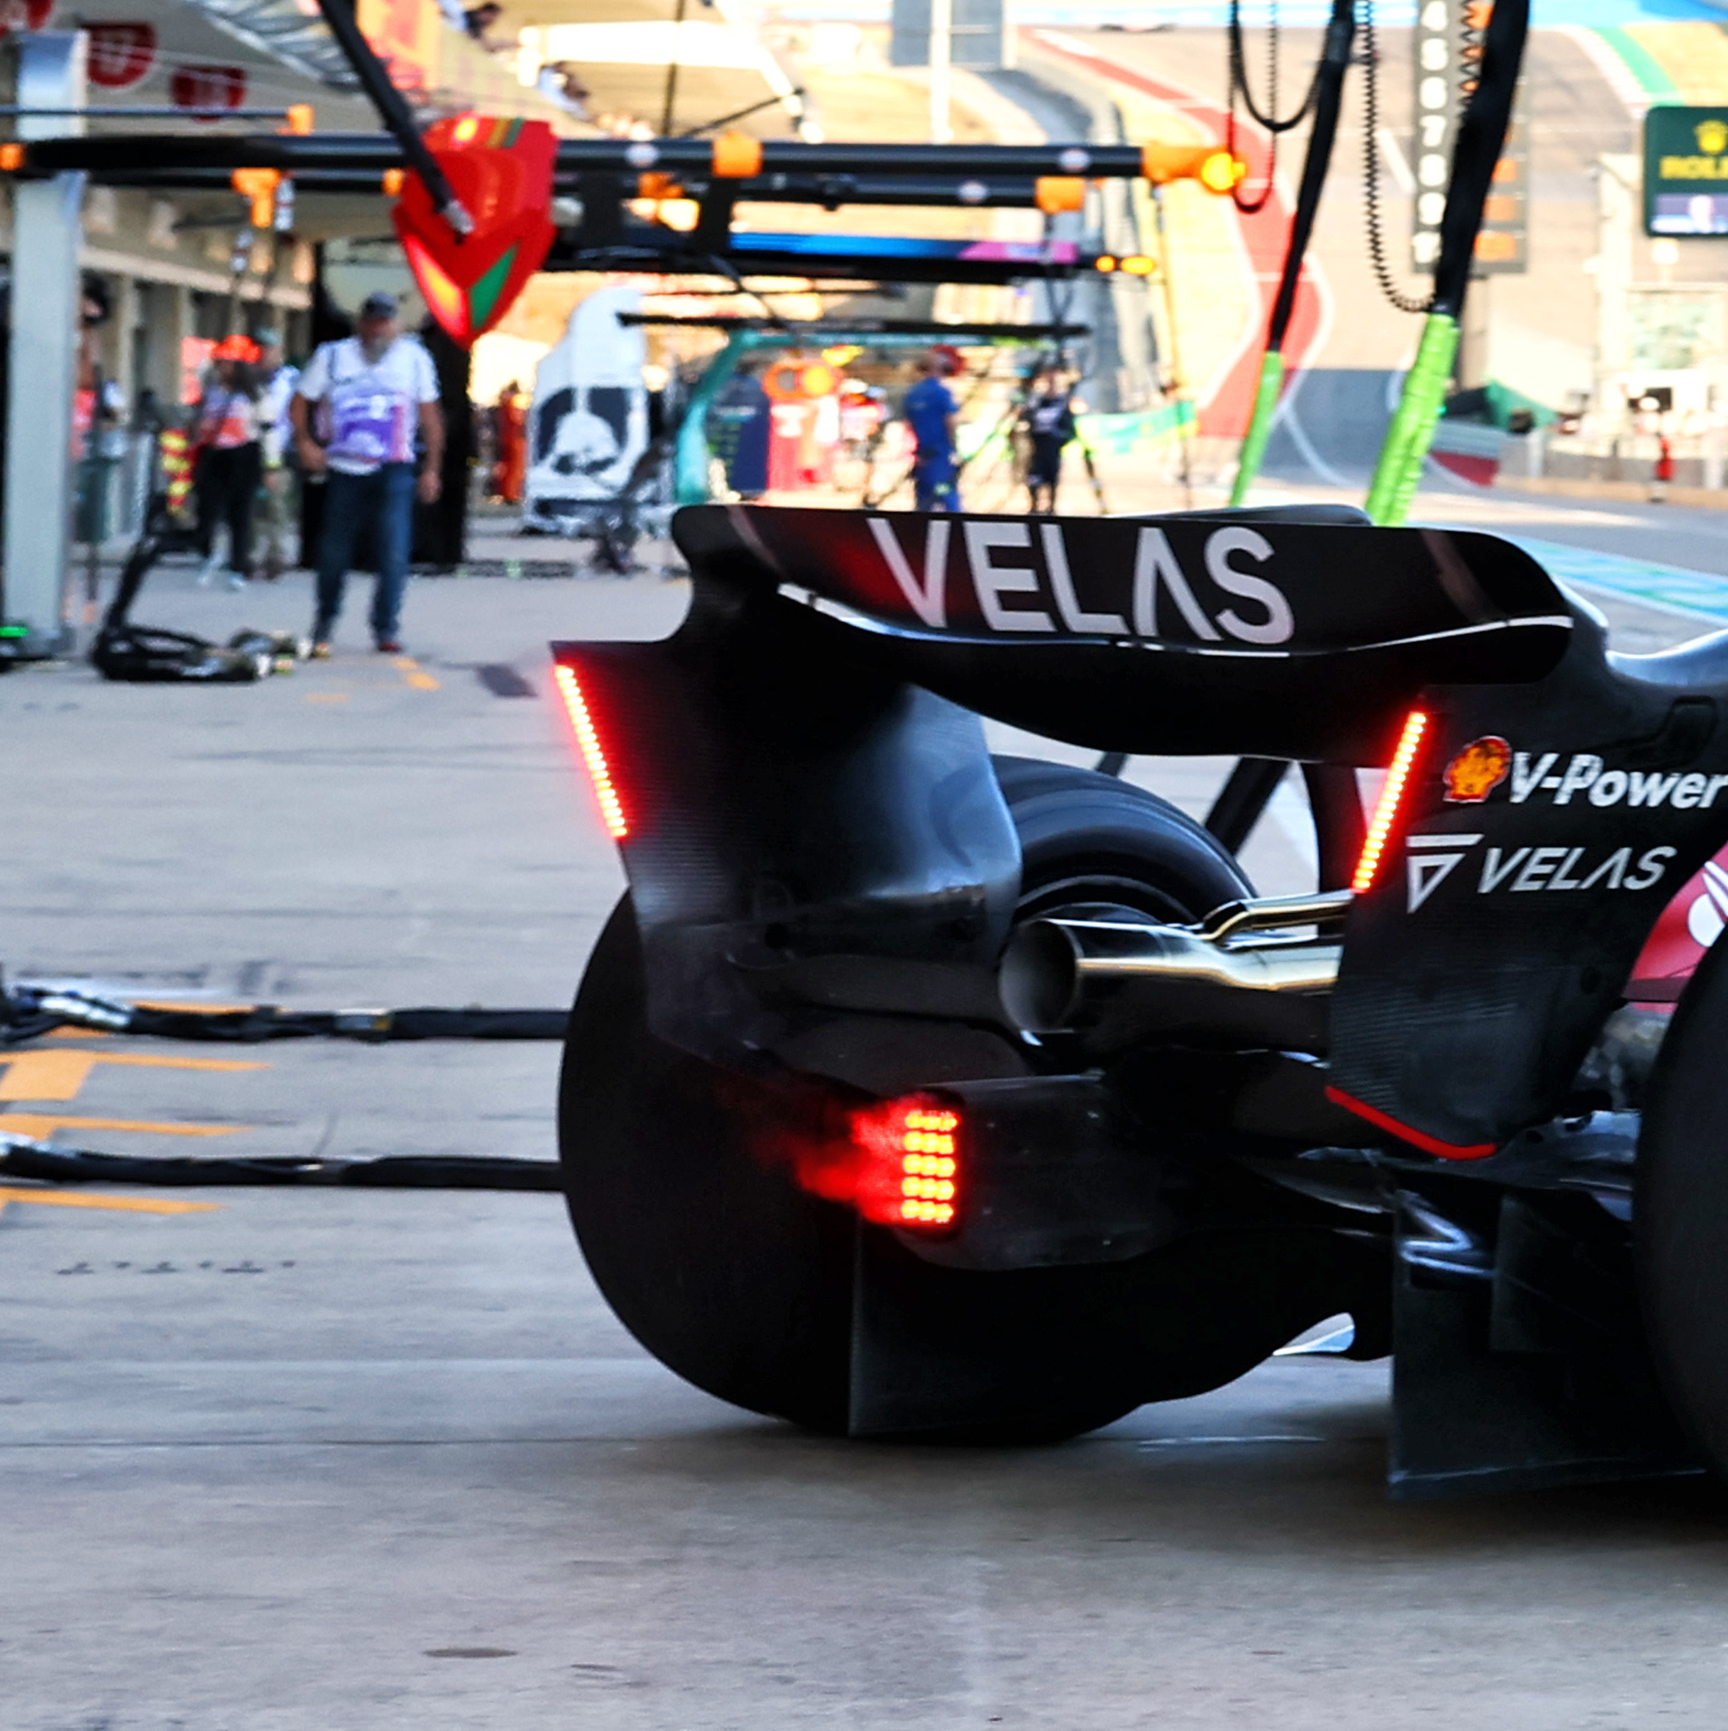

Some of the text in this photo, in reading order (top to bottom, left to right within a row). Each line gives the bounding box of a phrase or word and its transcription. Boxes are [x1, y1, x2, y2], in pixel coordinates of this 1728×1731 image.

[1421, 0, 1448, 31] 4
[1420, 38, 1449, 70] 5
[1420, 76, 1447, 109] 6
[1419, 115, 1447, 147] 7
[866, 517, 1295, 645] VELAS
[1477, 846, 1677, 894] VELAS
